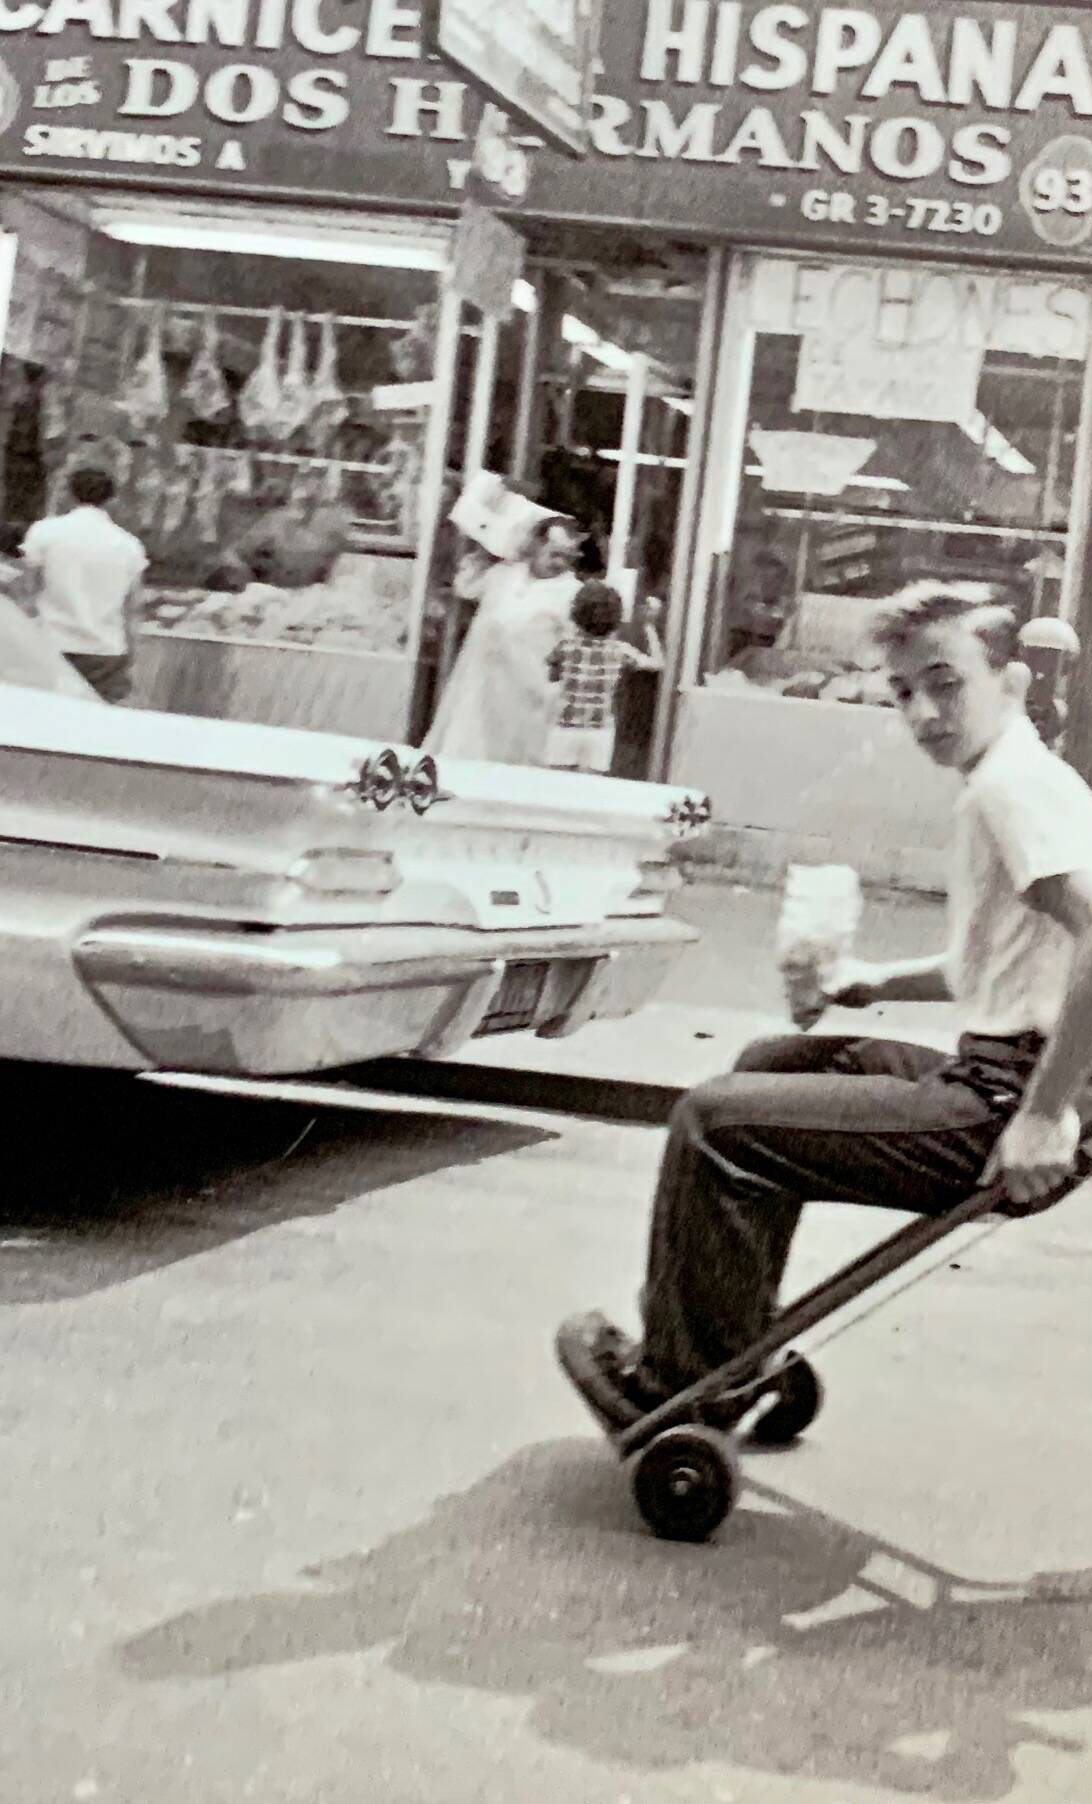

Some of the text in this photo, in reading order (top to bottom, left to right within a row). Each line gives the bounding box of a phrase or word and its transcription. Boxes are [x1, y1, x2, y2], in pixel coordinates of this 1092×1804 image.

[117, 57, 1012, 185] DOS HRMANOS
[215, 139, 246, 171] A
[801, 190, 855, 225] GR
[865, 198, 1003, 238] 3-7230
